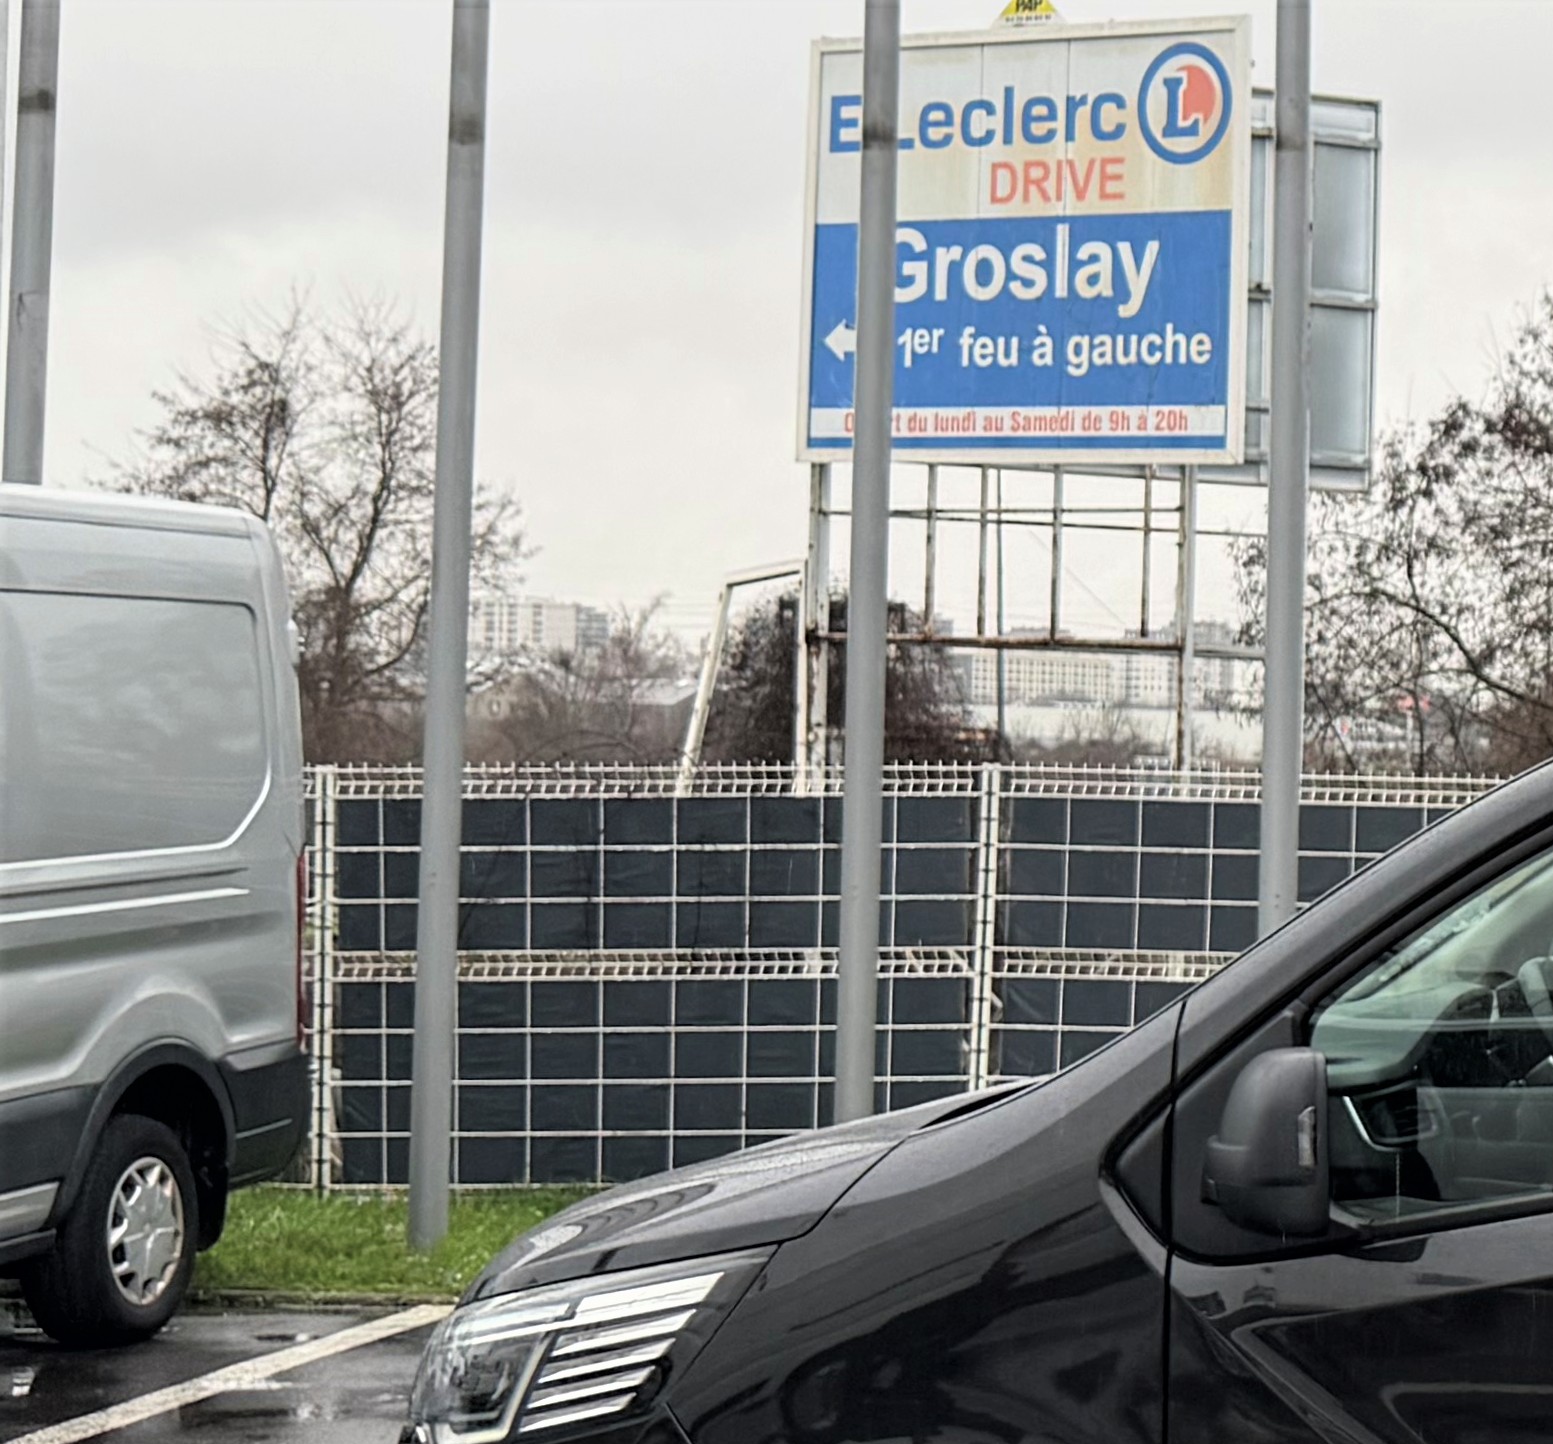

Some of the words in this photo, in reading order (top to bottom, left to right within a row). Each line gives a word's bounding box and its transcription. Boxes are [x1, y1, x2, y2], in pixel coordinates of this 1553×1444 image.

[988, 157, 1127, 206] DRIVE
[893, 223, 1161, 319] Groslay
[897, 326, 945, 368] 1er
[958, 325, 1019, 368] feu
[1031, 324, 1054, 367] à
[1065, 322, 1212, 378] gauche
[907, 411, 928, 433] du
[934, 410, 977, 433] lundi
[982, 415, 1005, 433] au
[1010, 410, 1075, 433] Samedi
[1081, 409, 1102, 432] de
[1108, 409, 1131, 432] 9h
[1137, 409, 1148, 432] à
[1154, 408, 1189, 432] 20h
